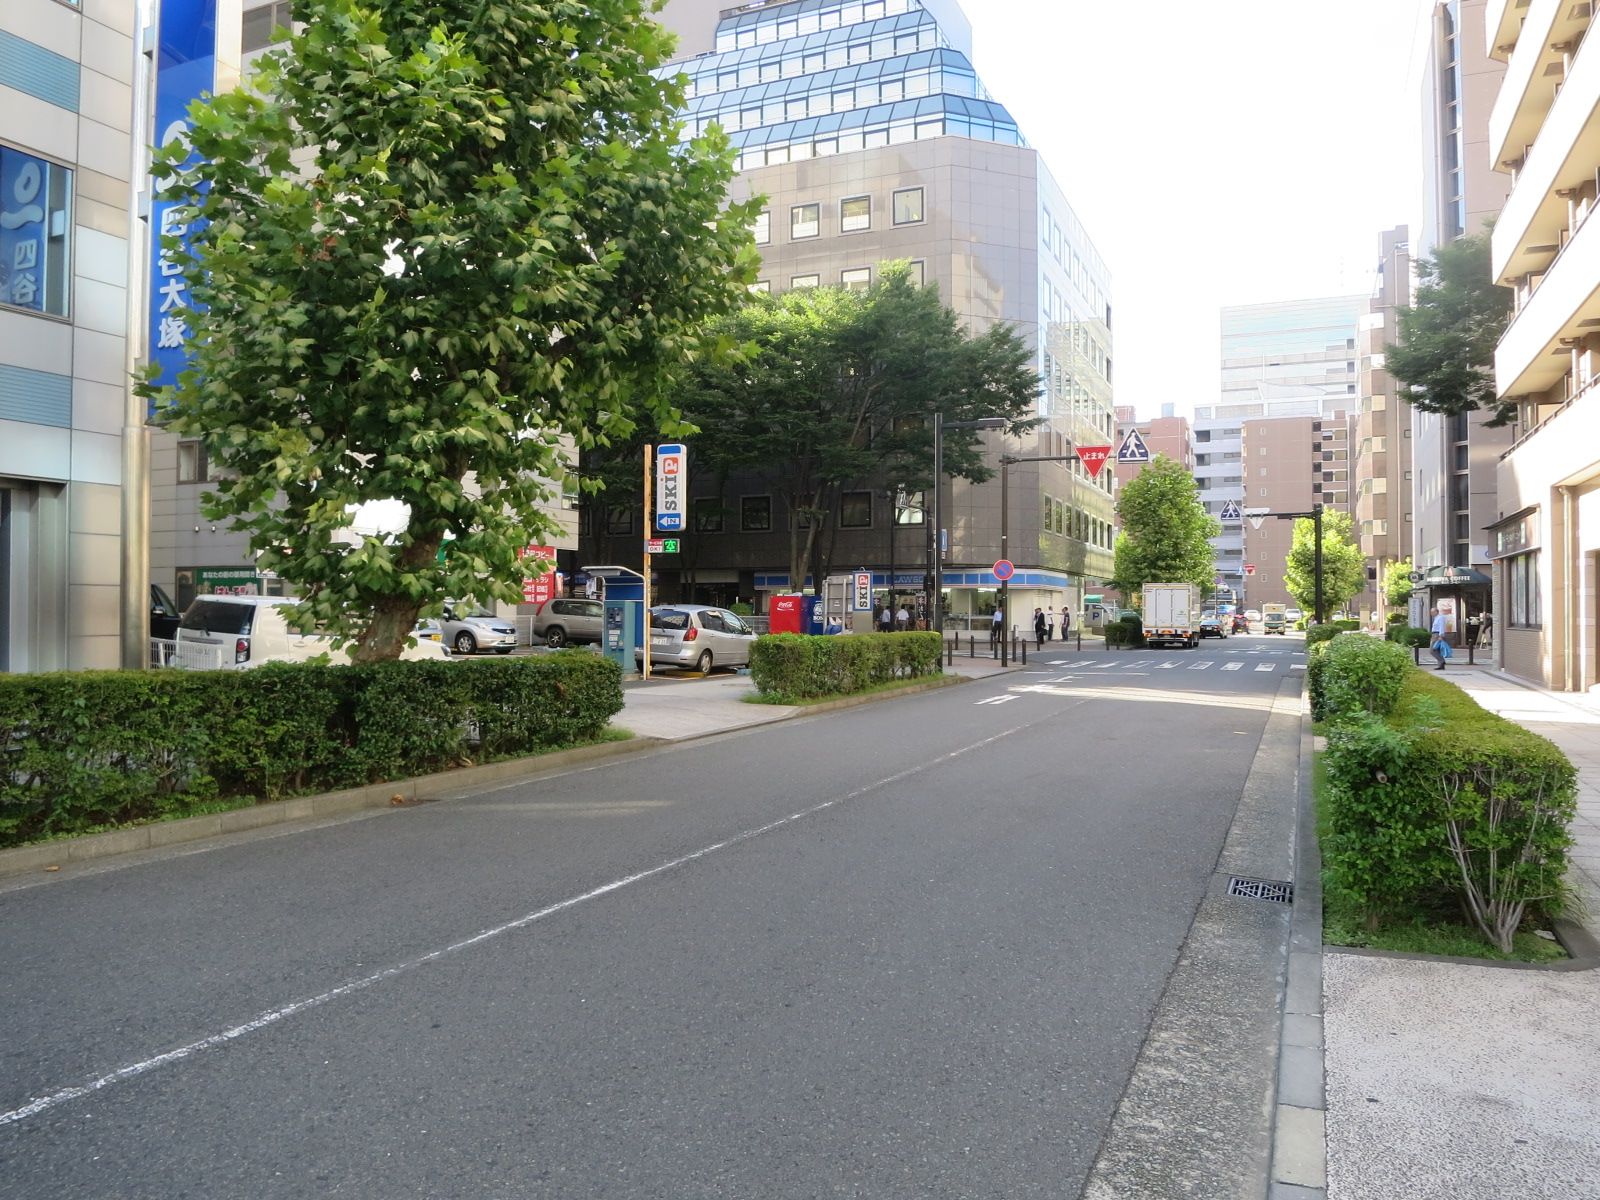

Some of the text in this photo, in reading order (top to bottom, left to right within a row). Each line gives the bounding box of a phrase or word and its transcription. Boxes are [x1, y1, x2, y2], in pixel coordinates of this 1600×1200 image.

[1083, 452, 1105, 460] 止まれ
[662, 457, 679, 511] SKIP
[857, 575, 868, 607] SKIP
[1092, 612, 1100, 620] P
